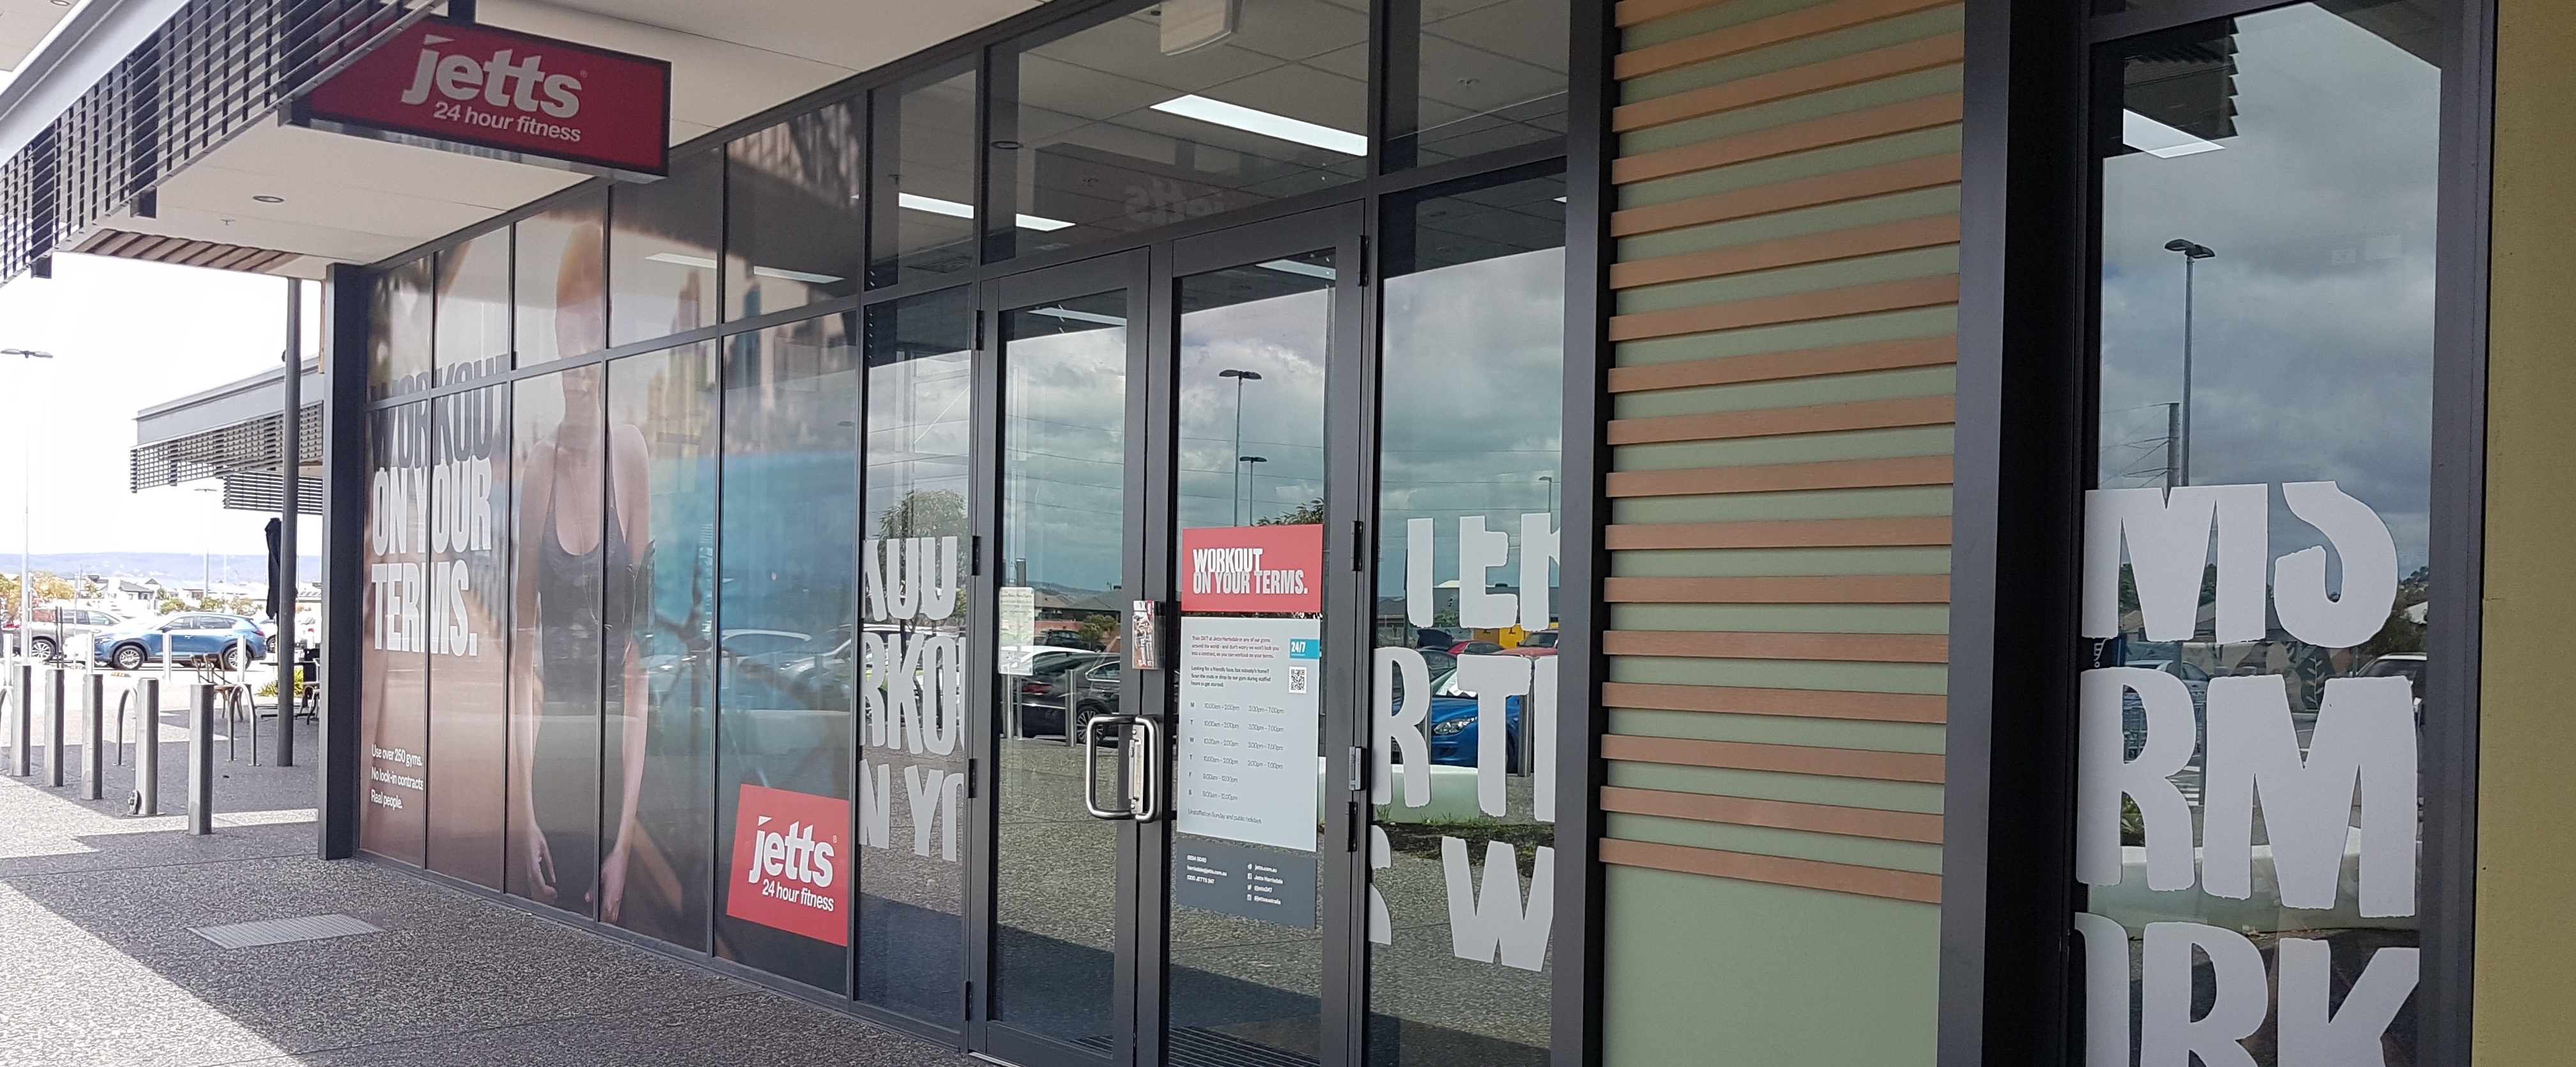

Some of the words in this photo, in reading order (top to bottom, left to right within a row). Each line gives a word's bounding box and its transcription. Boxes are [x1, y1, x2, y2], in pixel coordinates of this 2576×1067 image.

[401, 35, 580, 119] jetts
[434, 101, 460, 121] 24
[464, 109, 514, 132] hour
[516, 114, 581, 142] fitness
[371, 353, 509, 472] WORKOUT
[372, 466, 407, 557] ON
[414, 456, 491, 554] YOUR
[1193, 548, 1263, 572] WORKOUT
[1193, 571, 1211, 594] ON
[1215, 571, 1250, 594] YOUR
[1254, 569, 1308, 595] TERMS.
[372, 559, 477, 657] TERMS.
[1291, 641, 1306, 653] 24/7
[371, 744, 382, 759] Use
[383, 749, 395, 760] over
[394, 748, 406, 763] 250
[371, 767, 379, 781] No
[379, 768, 397, 785] lock-in
[2076, 666, 2418, 918] RM
[371, 789, 383, 804] Real
[748, 816, 835, 887] jetts
[762, 879, 775, 897] 24
[776, 883, 799, 903] hour
[800, 888, 834, 912] fitness
